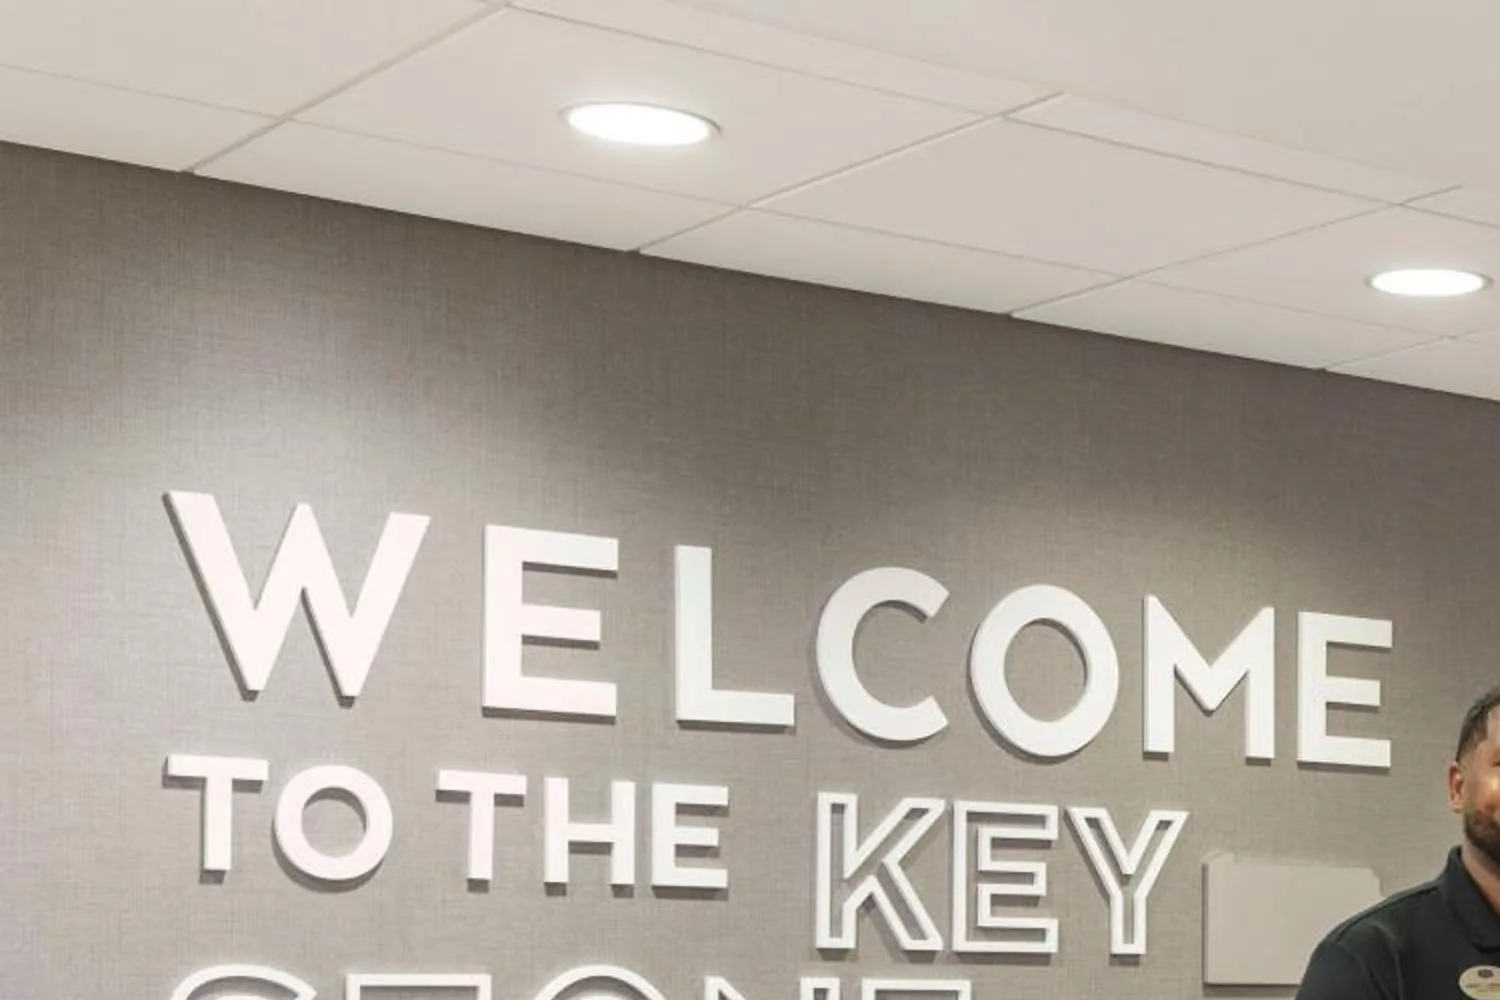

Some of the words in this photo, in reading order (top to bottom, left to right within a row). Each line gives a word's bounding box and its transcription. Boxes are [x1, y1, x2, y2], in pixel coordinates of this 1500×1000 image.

[164, 489, 1392, 769] WELCOME
[166, 753, 393, 881] TO
[436, 768, 730, 889] THE
[816, 791, 1190, 957] KEY
